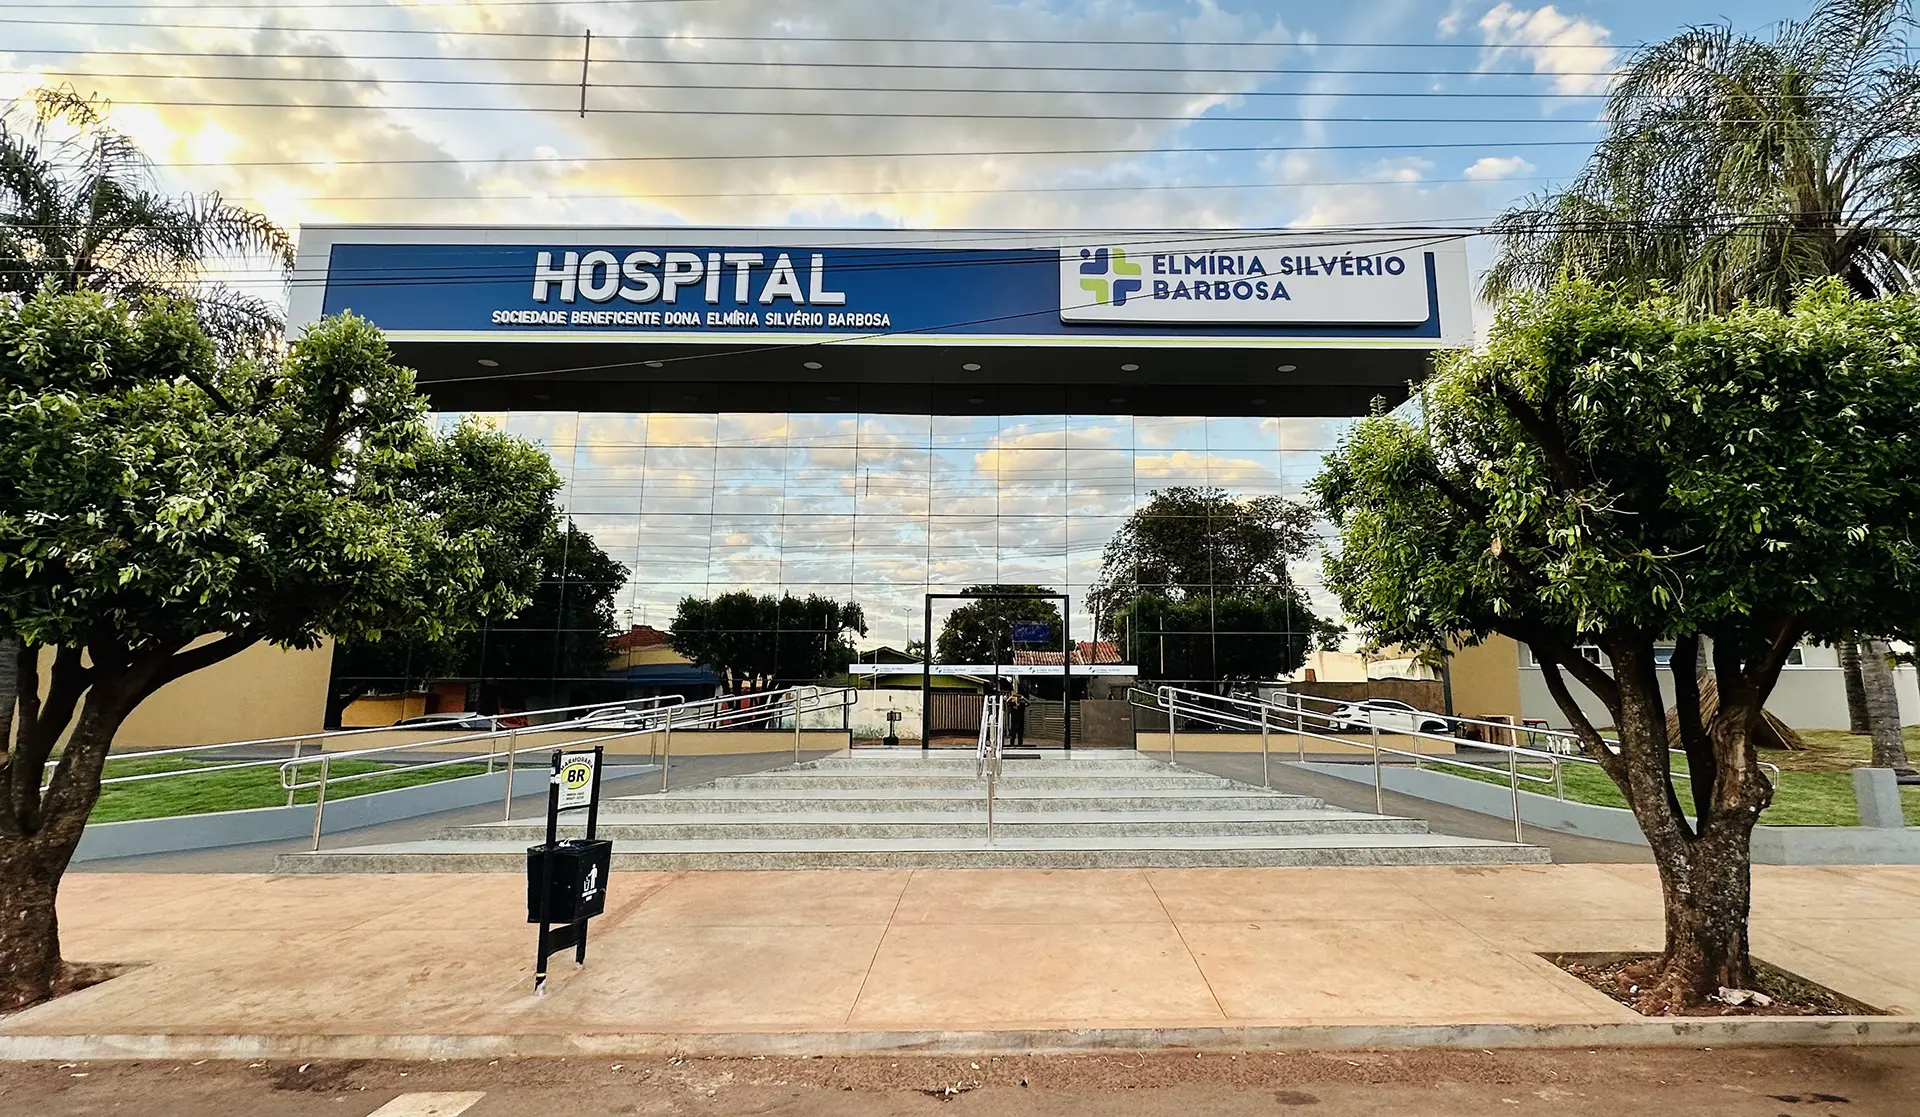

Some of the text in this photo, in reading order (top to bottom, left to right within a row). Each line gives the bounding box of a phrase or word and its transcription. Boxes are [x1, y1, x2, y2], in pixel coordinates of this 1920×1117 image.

[1152, 250, 1405, 276] ELMÍRIA SILVÉRIO
[532, 250, 846, 304] HOSPITAL
[1153, 280, 1291, 301] BARBOSA
[491, 309, 891, 327] SOCIEDADE BENEFICENTE DONA ELMÍRIA SILVÉRIO BARBOSA
[568, 769, 586, 783] BR
